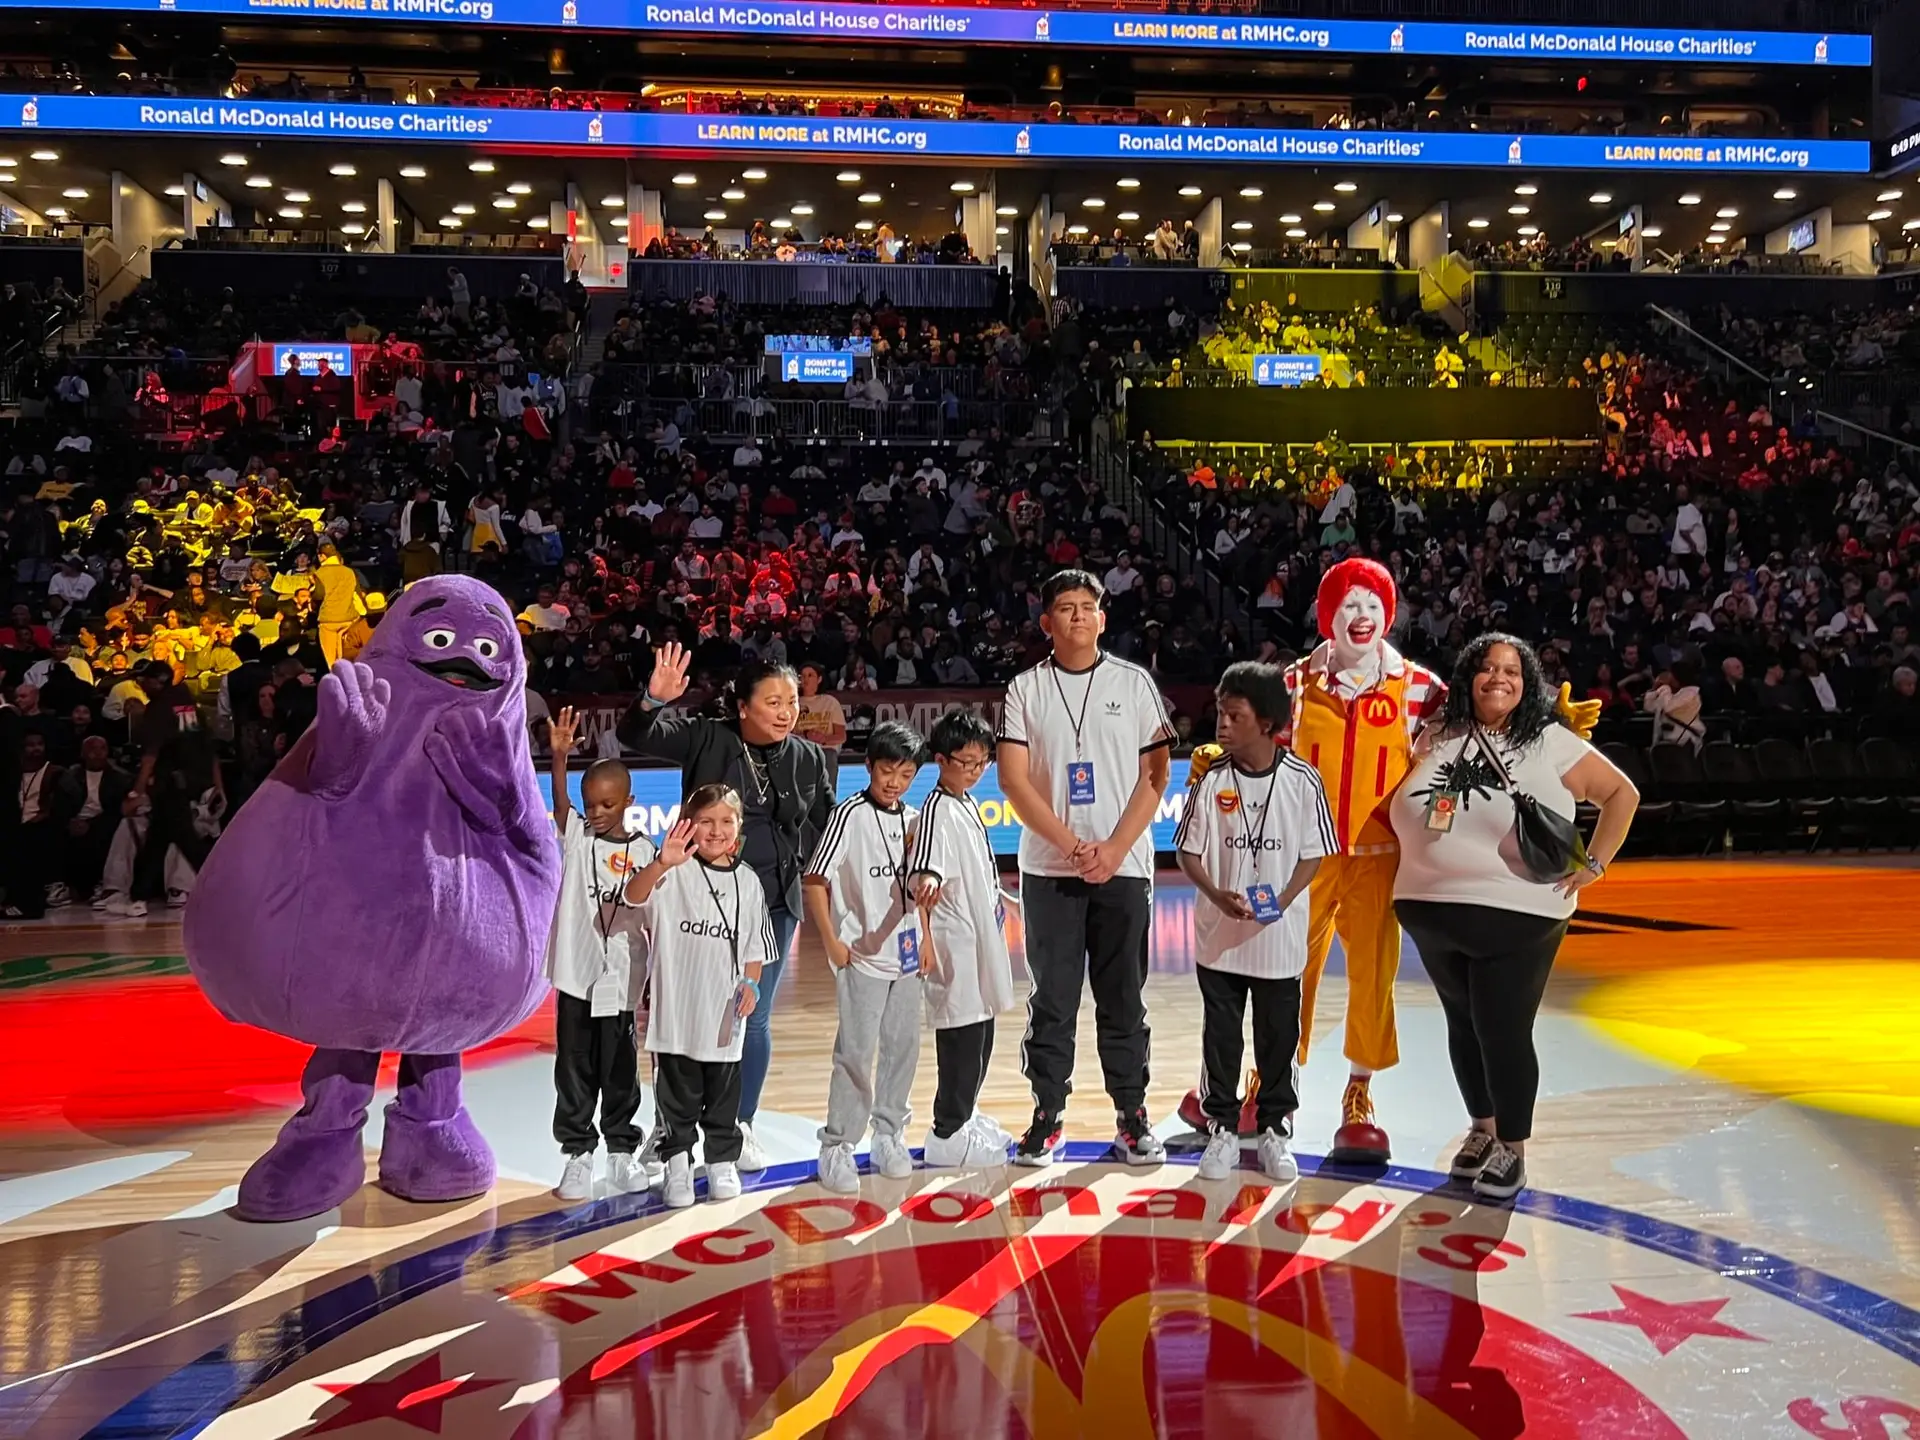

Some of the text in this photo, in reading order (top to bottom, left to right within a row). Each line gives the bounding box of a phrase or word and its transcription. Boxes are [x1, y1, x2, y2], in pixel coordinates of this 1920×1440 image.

[393, 0, 493, 19] RMHC.org
[646, 5, 714, 23] Ronald
[719, 8, 815, 27] McDonald
[820, 10, 879, 29] House
[1114, 22, 1329, 47] LEARN MORE at RMHC.org
[1465, 31, 1526, 49] Ronald
[1530, 33, 1617, 51] McDonald
[1620, 35, 1675, 53] House
[140, 105, 214, 125] Ronald
[219, 108, 324, 129] McDonald
[329, 112, 395, 131] House
[697, 123, 927, 149] LEARN MORE at RMHC.org
[1119, 133, 1183, 151] Ronald
[1187, 135, 1278, 153] McDonald
[1282, 137, 1339, 155] House
[1605, 145, 1809, 167] LEARN MORE at RMHC.org
[804, 367, 847, 378] RMHC.org
[805, 358, 846, 367] DONATE at
[1274, 362, 1305, 370] DONATE
[1273, 370, 1315, 380] RMHC.org
[496, 1183, 1527, 1325] McDonald's
